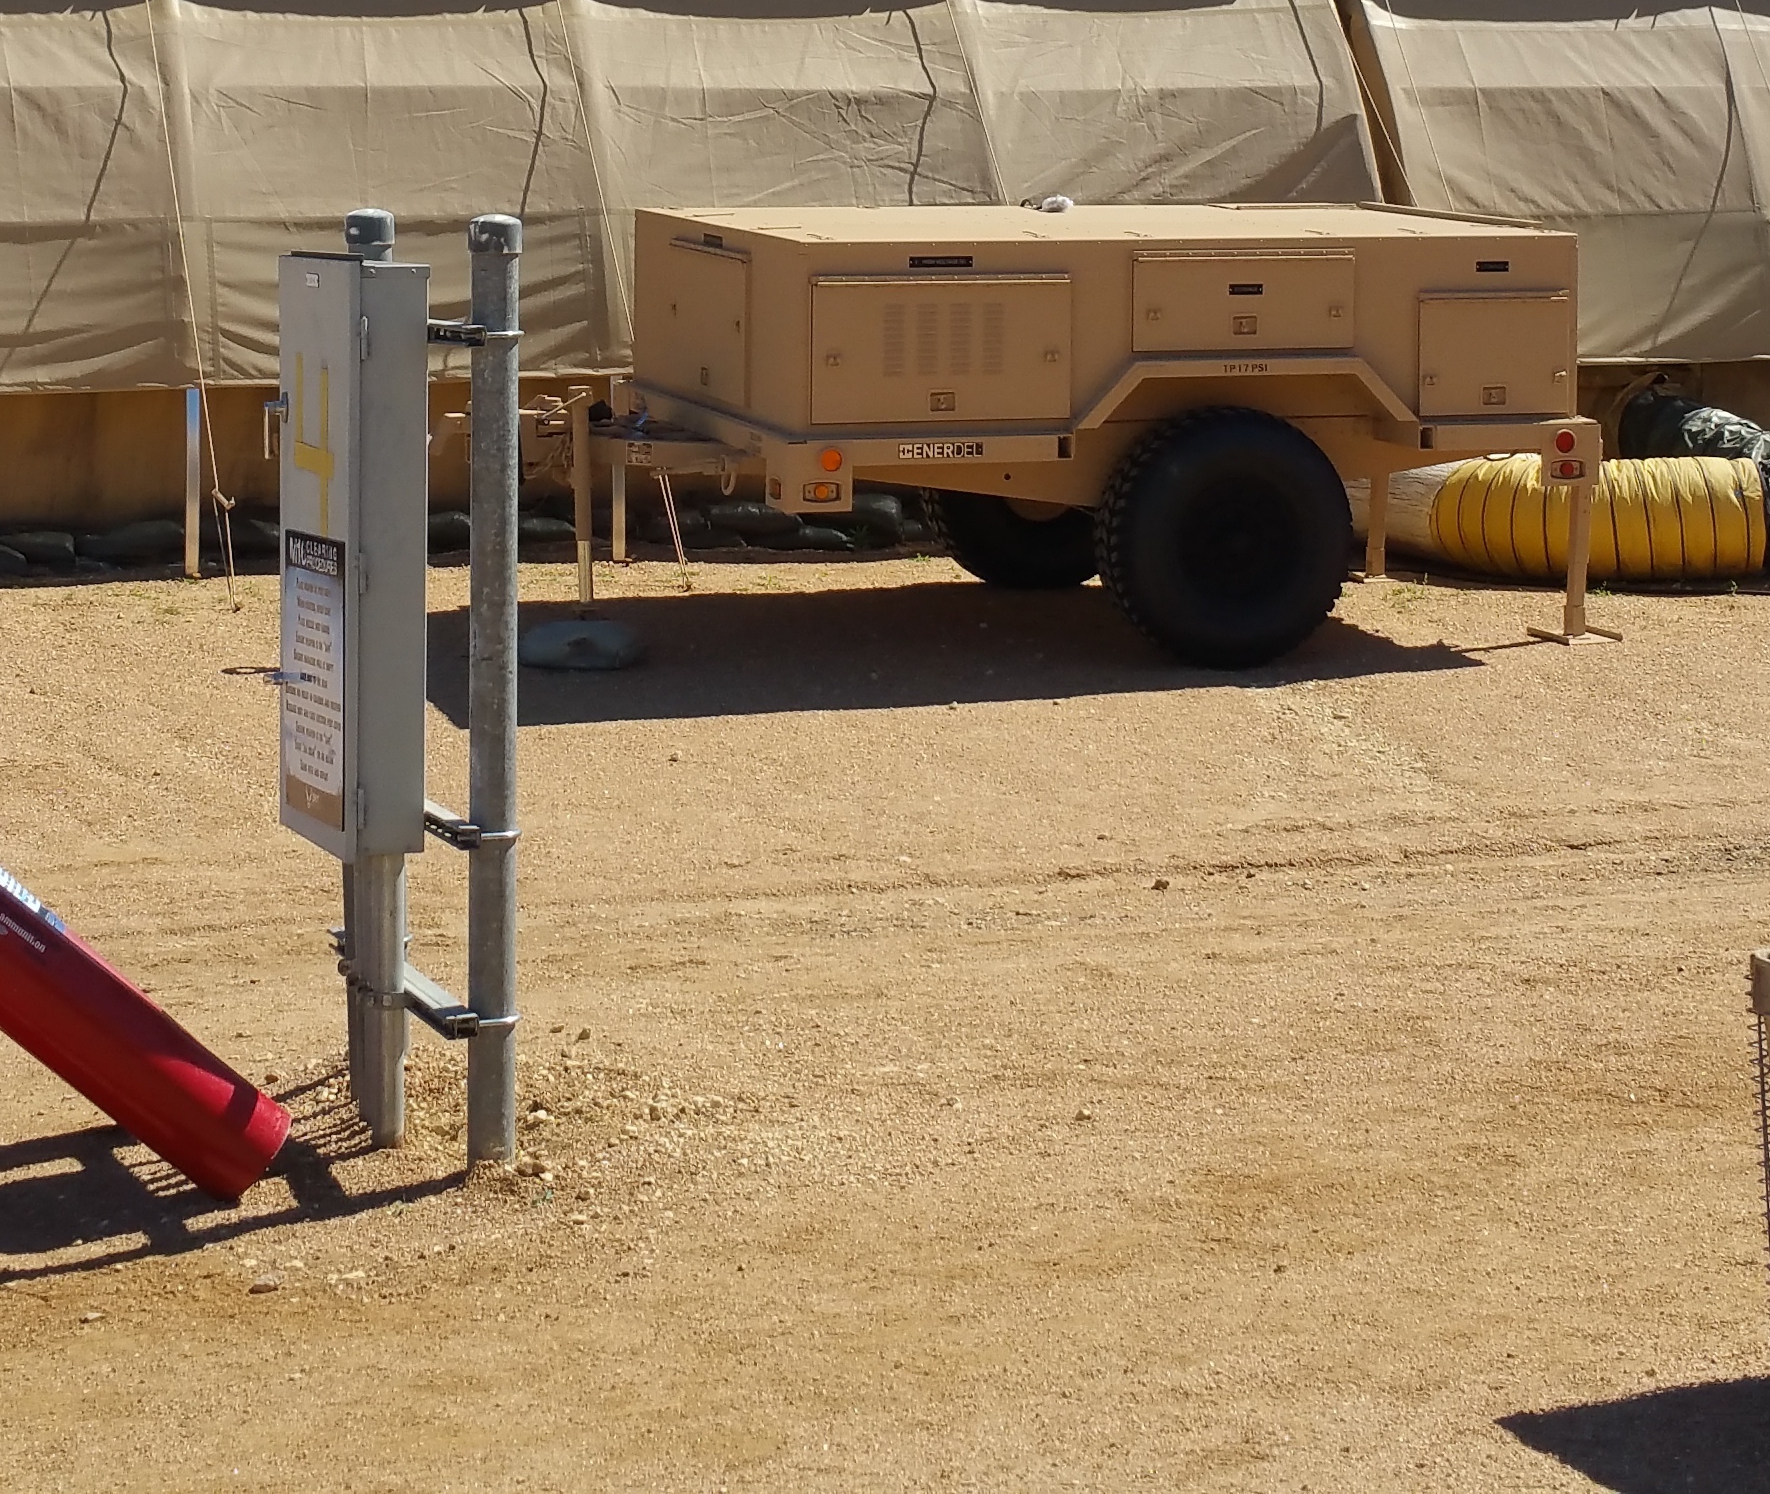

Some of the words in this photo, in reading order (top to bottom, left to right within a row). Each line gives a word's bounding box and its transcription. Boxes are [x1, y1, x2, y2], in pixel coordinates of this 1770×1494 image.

[1223, 364, 1236, 373] TP
[1238, 363, 1249, 373] 17
[1251, 363, 1268, 373] PSI
[294, 352, 334, 538] 4
[306, 540, 338, 561] CLEARING
